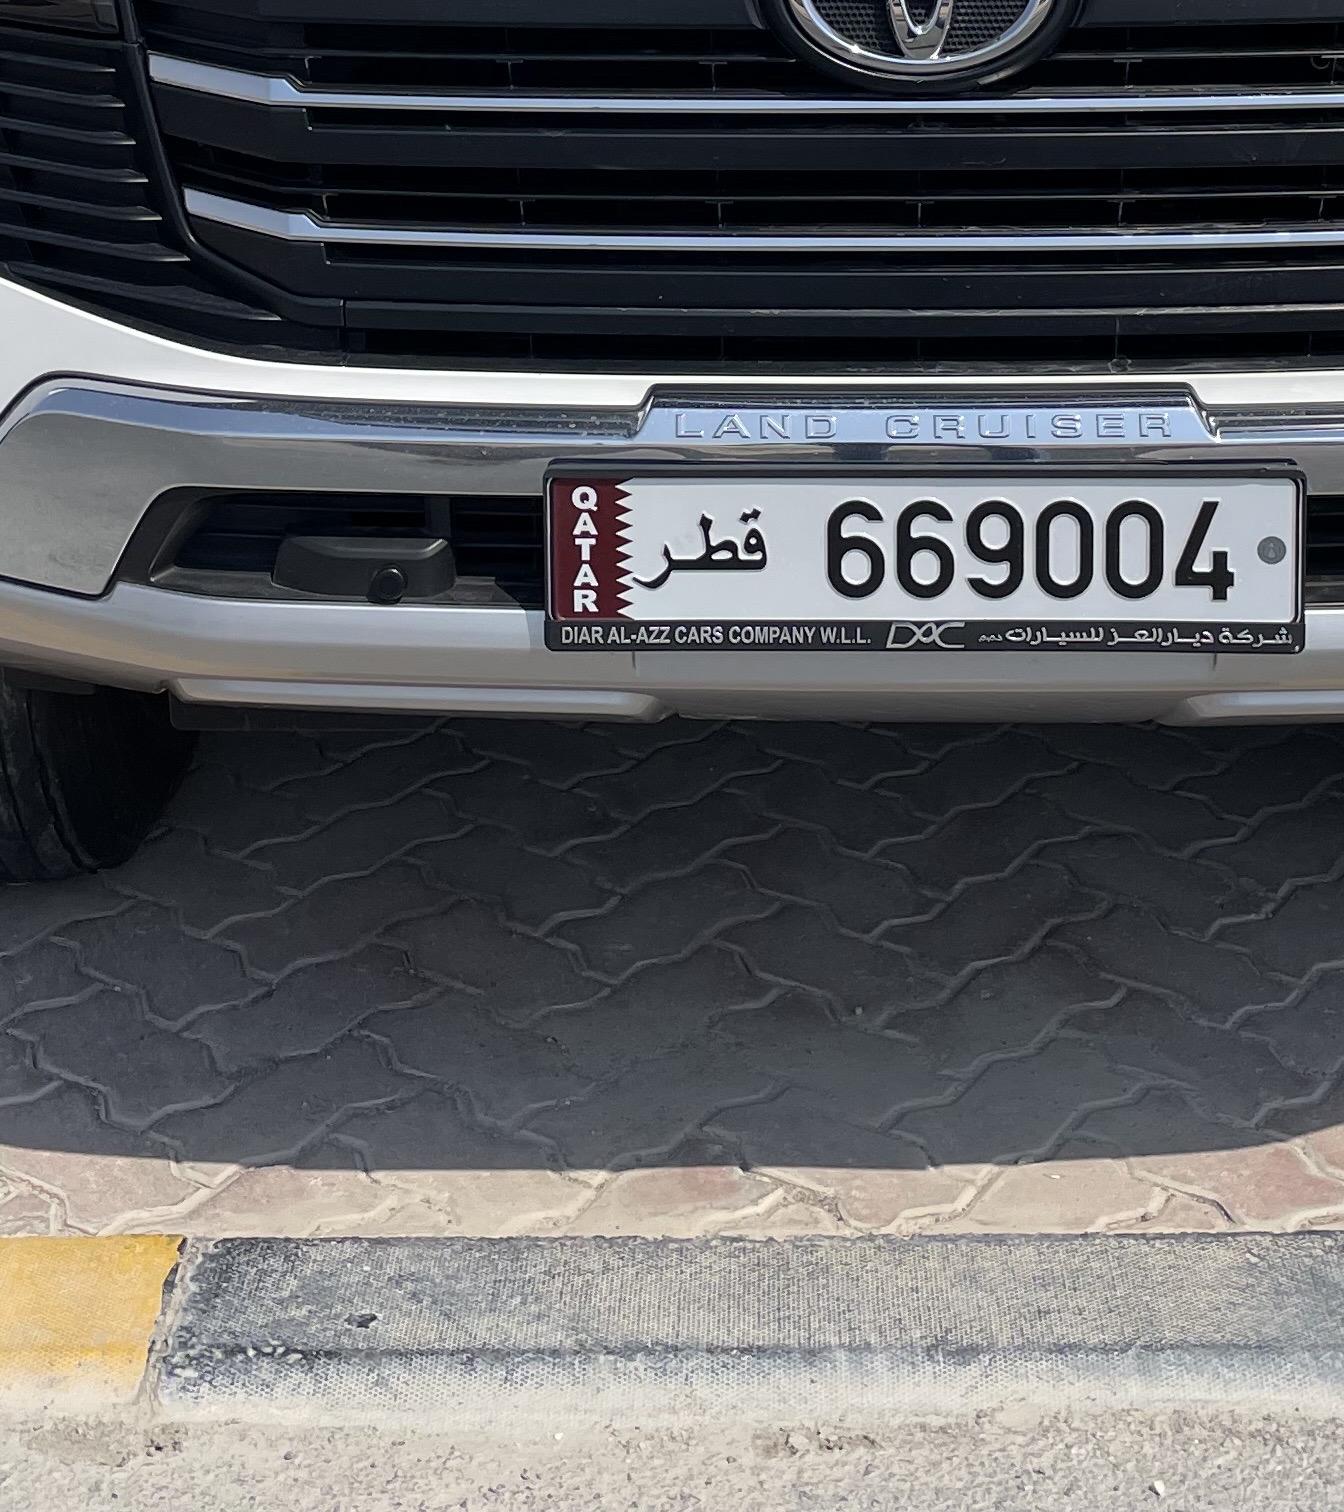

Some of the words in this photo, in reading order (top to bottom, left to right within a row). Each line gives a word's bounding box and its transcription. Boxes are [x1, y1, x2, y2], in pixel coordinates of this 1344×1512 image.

[675, 413, 839, 440] LAND
[885, 413, 1174, 440] CRUISER
[571, 485, 599, 613] QATAR
[632, 505, 768, 592] قطر
[826, 498, 1236, 601] 669004
[560, 626, 605, 645] DIAR
[606, 626, 670, 645] AL-AZZ
[674, 626, 724, 645] CARS
[727, 626, 816, 645] COMPANY
[819, 626, 872, 645] W.L.L.
[1005, 626, 1104, 646] للسيارات
[1218, 626, 1293, 648] شركة
